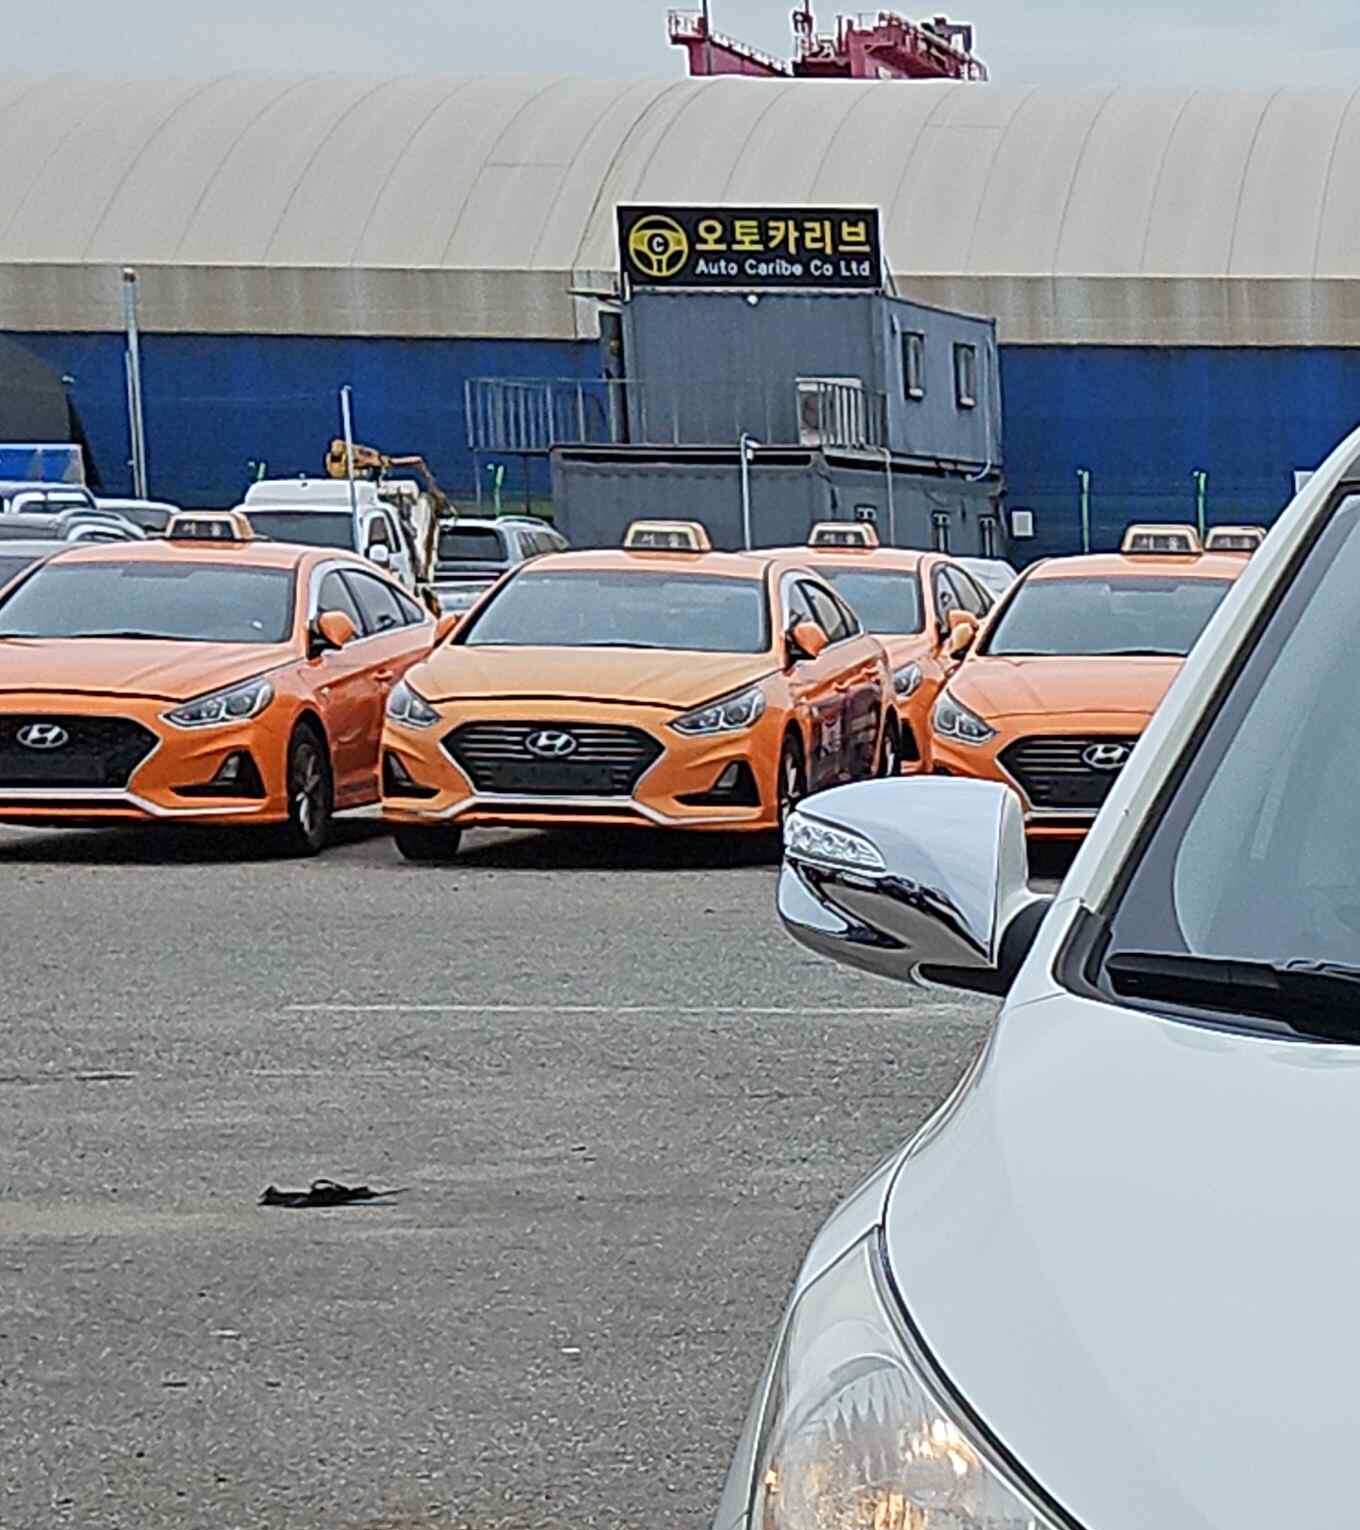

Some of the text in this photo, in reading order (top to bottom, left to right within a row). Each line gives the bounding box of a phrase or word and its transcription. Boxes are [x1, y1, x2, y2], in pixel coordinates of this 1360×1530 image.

[695, 219, 871, 254] 오토카리브
[695, 258, 738, 276] Auto
[810, 259, 834, 276] Co
[840, 260, 870, 276] Ltd
